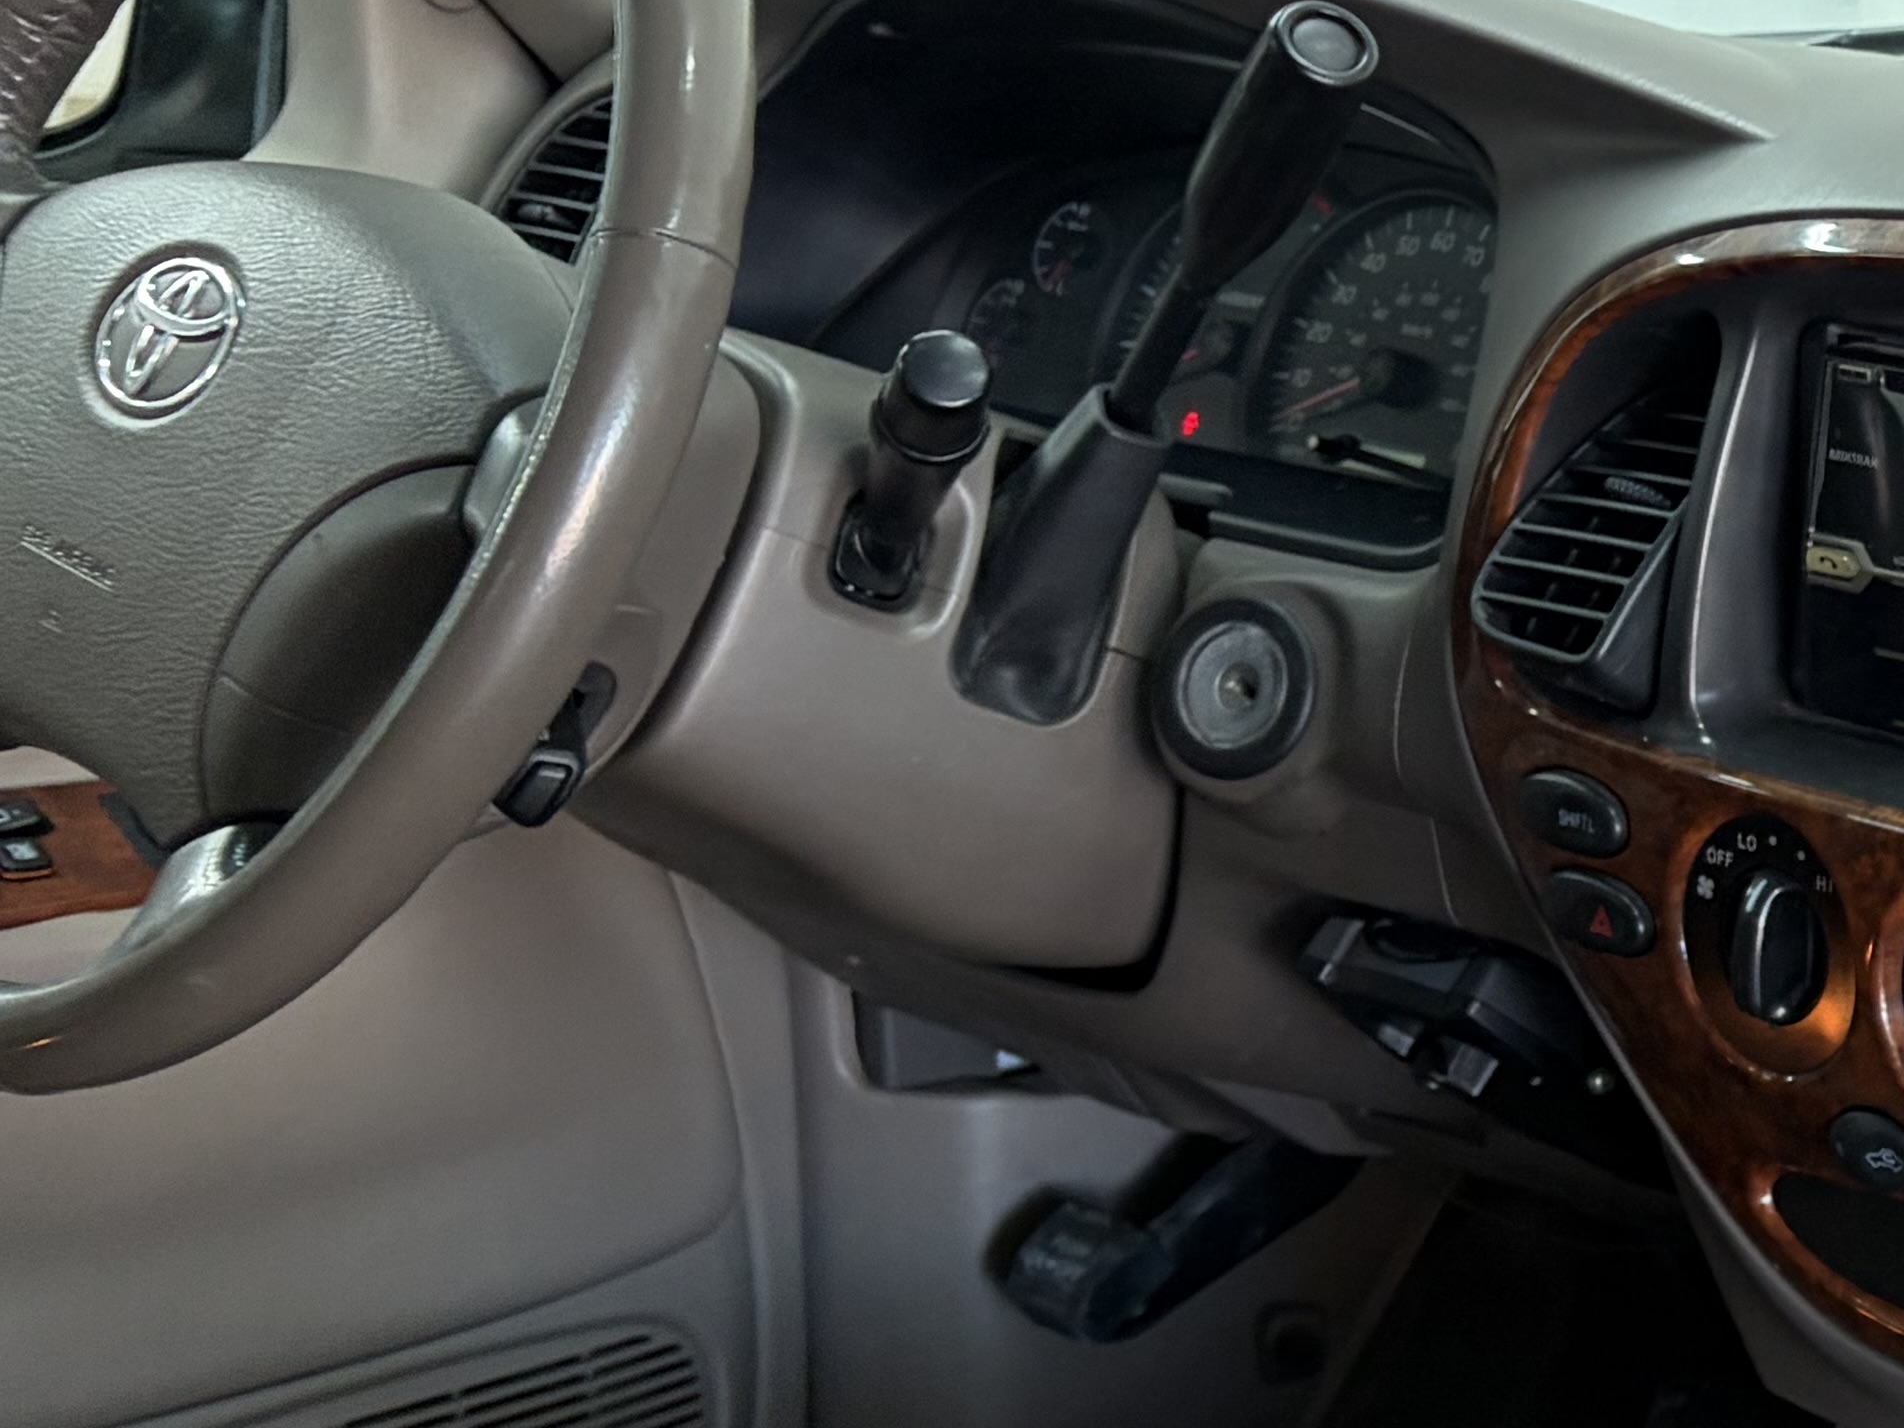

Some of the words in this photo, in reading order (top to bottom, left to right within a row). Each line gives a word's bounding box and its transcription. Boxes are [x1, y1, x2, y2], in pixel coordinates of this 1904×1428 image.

[1737, 831, 1758, 852] LO
[1706, 845, 1734, 868] OFF
[1816, 875, 1834, 893] HI
